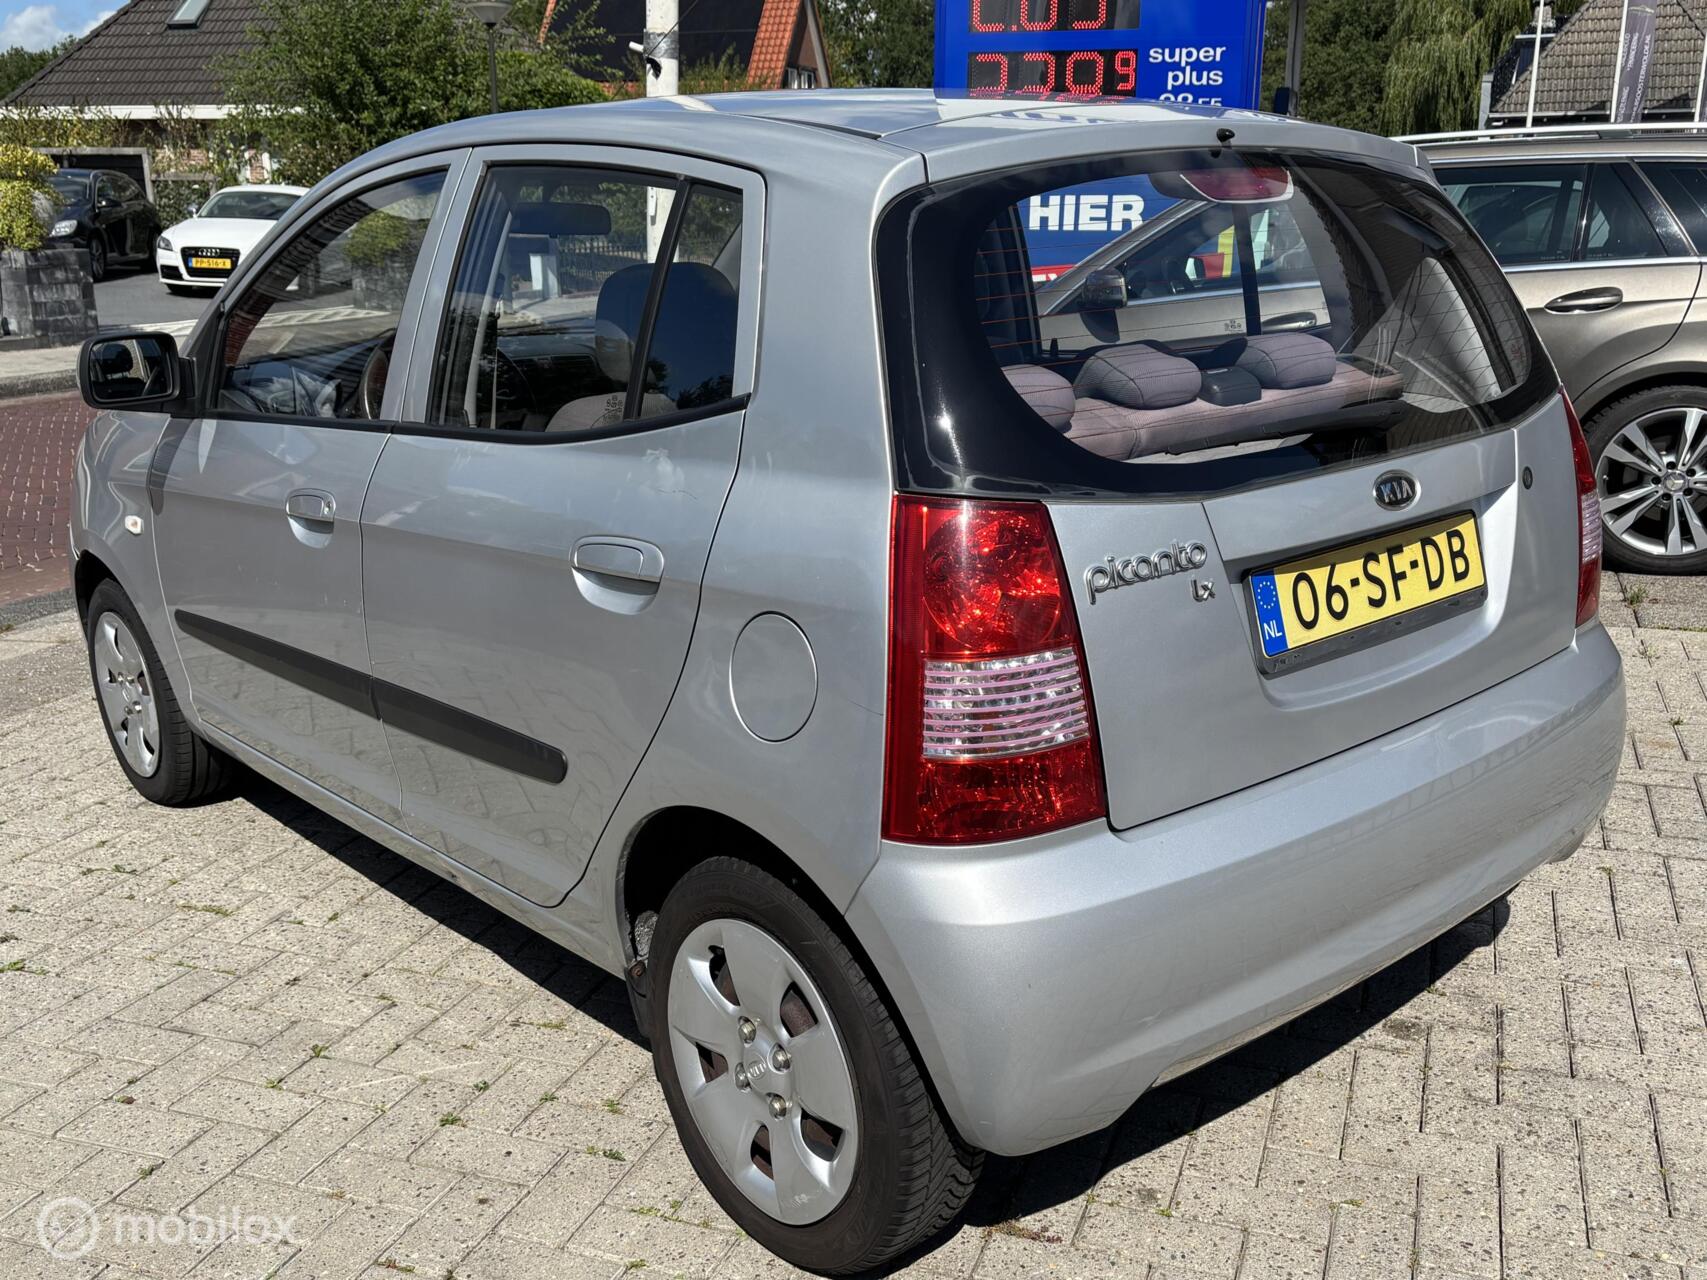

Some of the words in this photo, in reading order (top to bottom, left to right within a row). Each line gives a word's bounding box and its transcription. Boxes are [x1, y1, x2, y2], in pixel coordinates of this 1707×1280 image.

[1148, 46, 1227, 67] super
[1167, 65, 1223, 91] plus
[1028, 194, 1145, 231] HIER
[1379, 479, 1416, 504] KIA
[1083, 539, 1208, 605] picanto
[1292, 529, 1471, 630] 06-SF-DB
[1263, 620, 1283, 640] NL
